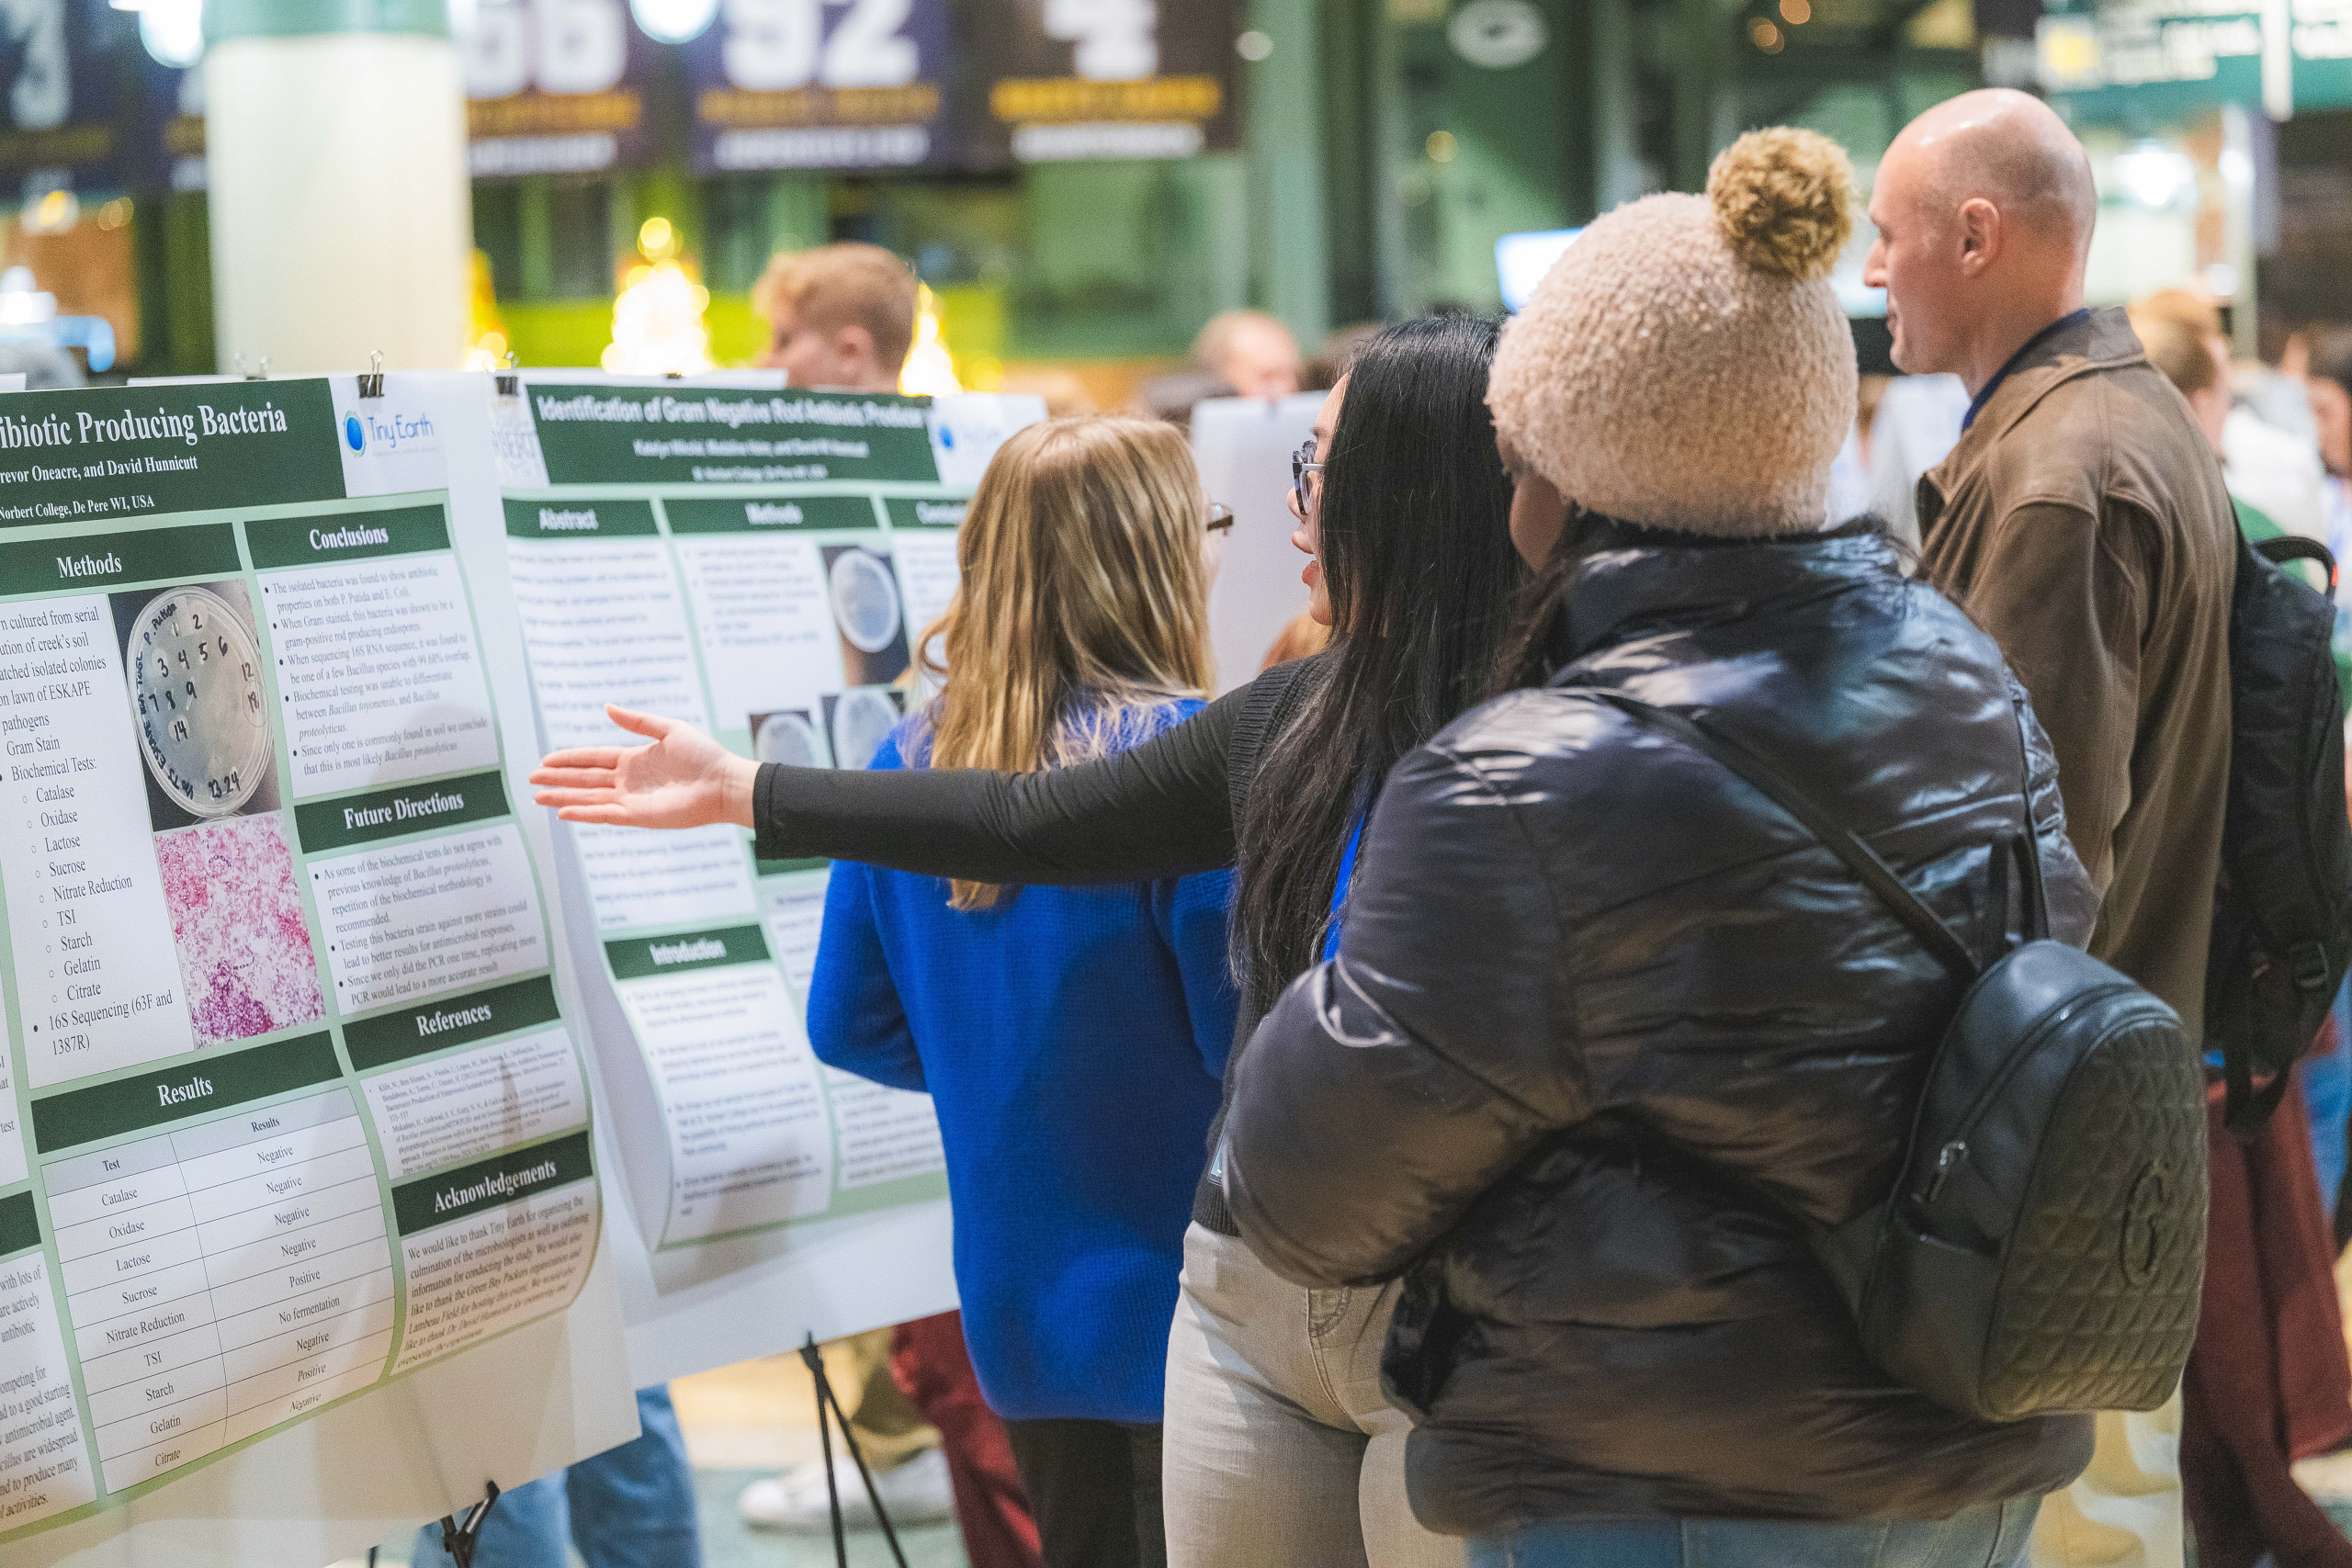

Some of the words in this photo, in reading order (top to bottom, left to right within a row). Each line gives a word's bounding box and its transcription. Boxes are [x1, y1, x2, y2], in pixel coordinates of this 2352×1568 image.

[75, 407, 196, 446] Producing
[197, 401, 288, 435] Bacteria
[368, 416, 396, 448] Tiny
[395, 413, 434, 439] Earth
[31, 465, 81, 481] Oneacre,
[83, 460, 105, 477] and
[106, 457, 142, 475] David
[143, 455, 198, 472] Hunnicutt
[35, 502, 72, 518] College,
[72, 501, 85, 513] De
[86, 499, 108, 513] Pere
[109, 496, 130, 511] WI,
[130, 494, 154, 508] USA
[538, 508, 599, 530] Abstract
[309, 524, 389, 549] Conclusions
[56, 552, 121, 578] Methods
[271, 581, 287, 593] The
[287, 578, 315, 592] isolated
[314, 578, 344, 589] bacteria
[9, 611, 48, 629] cultured
[49, 610, 73, 625] from
[74, 605, 99, 623] serial
[192, 614, 203, 629] 2
[25, 637, 36, 652] of
[38, 634, 70, 651] creek’s
[72, 631, 89, 648] soil
[30, 658, 67, 677] isolated
[69, 654, 106, 672] colonies
[157, 658, 169, 677] 3
[178, 649, 189, 670] 4
[198, 642, 209, 660] 5
[218, 636, 228, 657] 6
[10, 689, 35, 705] lawn
[37, 684, 47, 701] of
[48, 680, 91, 699] ESKAPE
[148, 693, 159, 712] 7
[165, 690, 175, 709] 8
[186, 681, 197, 699] 9
[1, 714, 50, 735] pathogens
[174, 720, 187, 741] 14
[6, 740, 34, 756] Gram
[35, 734, 60, 751] Stain
[10, 758, 70, 781] Biochemical
[70, 756, 96, 772] Tests:
[36, 784, 74, 802] Catalase
[223, 771, 241, 794] 24
[40, 808, 77, 827] Oxidase
[343, 807, 392, 829] Future
[393, 792, 464, 819] Directions
[44, 836, 80, 852] Lactose
[49, 860, 85, 876] Sucrose
[51, 885, 85, 901] Nitrate
[86, 874, 132, 895] Reduction
[56, 908, 75, 926] TSI
[60, 931, 92, 951] Starch
[649, 937, 727, 965] Introduction
[63, 955, 100, 976] Gelatin
[343, 954, 360, 969] lead
[361, 955, 369, 964] to
[369, 950, 392, 964] better
[393, 942, 418, 958] results
[66, 983, 101, 1000] Citrate
[49, 1012, 68, 1030] 16S
[71, 1001, 130, 1026] Sequencing
[130, 993, 152, 1015] (63F
[155, 988, 173, 1007] and
[415, 1004, 492, 1036] References
[52, 1033, 89, 1055] 1387R)
[156, 1077, 213, 1106] Results
[250, 1117, 279, 1132] Results
[101, 1158, 120, 1171] Test
[256, 1145, 293, 1163] Negative
[266, 1176, 301, 1194] Negative
[435, 1159, 557, 1213] Acknowledgements
[101, 1189, 138, 1206] Catalase
[274, 1207, 309, 1225] Negative
[108, 1222, 144, 1238] Oxidase
[280, 1238, 316, 1257] Negative
[115, 1254, 150, 1271] Lactose
[16, 1270, 32, 1285] lots
[32, 1264, 40, 1280] of
[288, 1269, 320, 1288] Positive
[11, 1292, 39, 1313] actively
[121, 1286, 157, 1303] Sucrose
[277, 1311, 291, 1324] No
[292, 1296, 340, 1319] fermentation
[0, 1318, 35, 1342] antibiotic
[106, 1326, 138, 1343] Nitrate
[140, 1312, 185, 1333] Reduction
[296, 1332, 329, 1351] Negative
[143, 1350, 161, 1366] TSI
[35, 1365, 46, 1381] for
[297, 1363, 325, 1382] Positive
[7, 1404, 17, 1416] to
[17, 1402, 24, 1413] a
[24, 1390, 43, 1415] good
[43, 1383, 71, 1403] starting
[145, 1382, 174, 1401] Starch
[290, 1391, 321, 1413] Negative
[4, 1411, 54, 1444] antimicrobial
[54, 1405, 75, 1427] agent.
[150, 1415, 181, 1434] Gelatin
[23, 1448, 36, 1462] are
[37, 1427, 78, 1455] widespread
[154, 1450, 180, 1466] Citrate
[12, 1479, 21, 1491] to
[22, 1465, 55, 1492] produce
[57, 1457, 77, 1473] many
[6, 1492, 48, 1517] activities.
